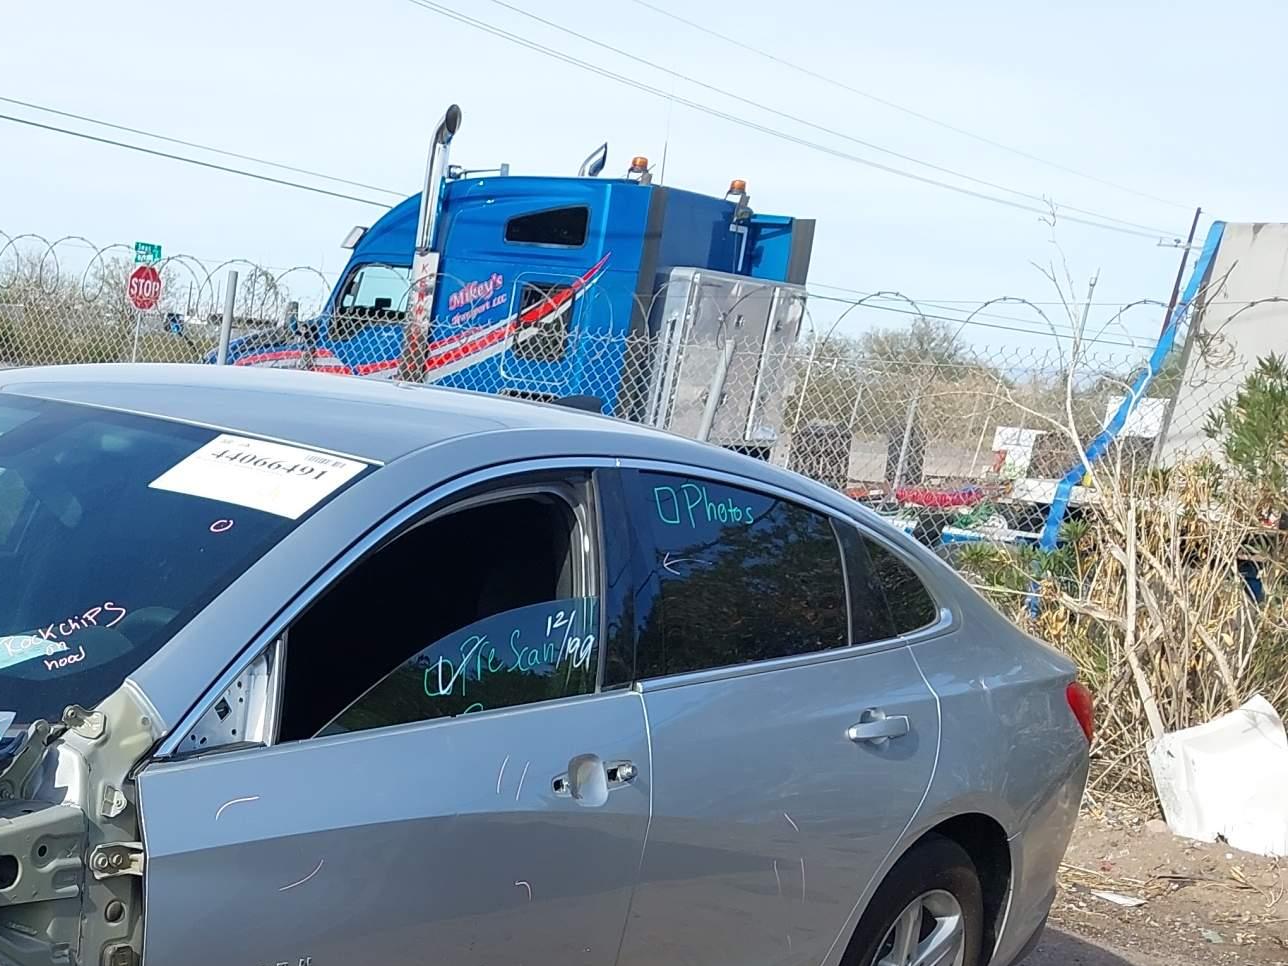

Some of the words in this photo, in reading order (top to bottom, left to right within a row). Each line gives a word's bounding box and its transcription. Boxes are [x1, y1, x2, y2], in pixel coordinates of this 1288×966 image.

[131, 277, 160, 298] STOP
[210, 449, 329, 480] 44066491
[43, 645, 86, 671] hood
